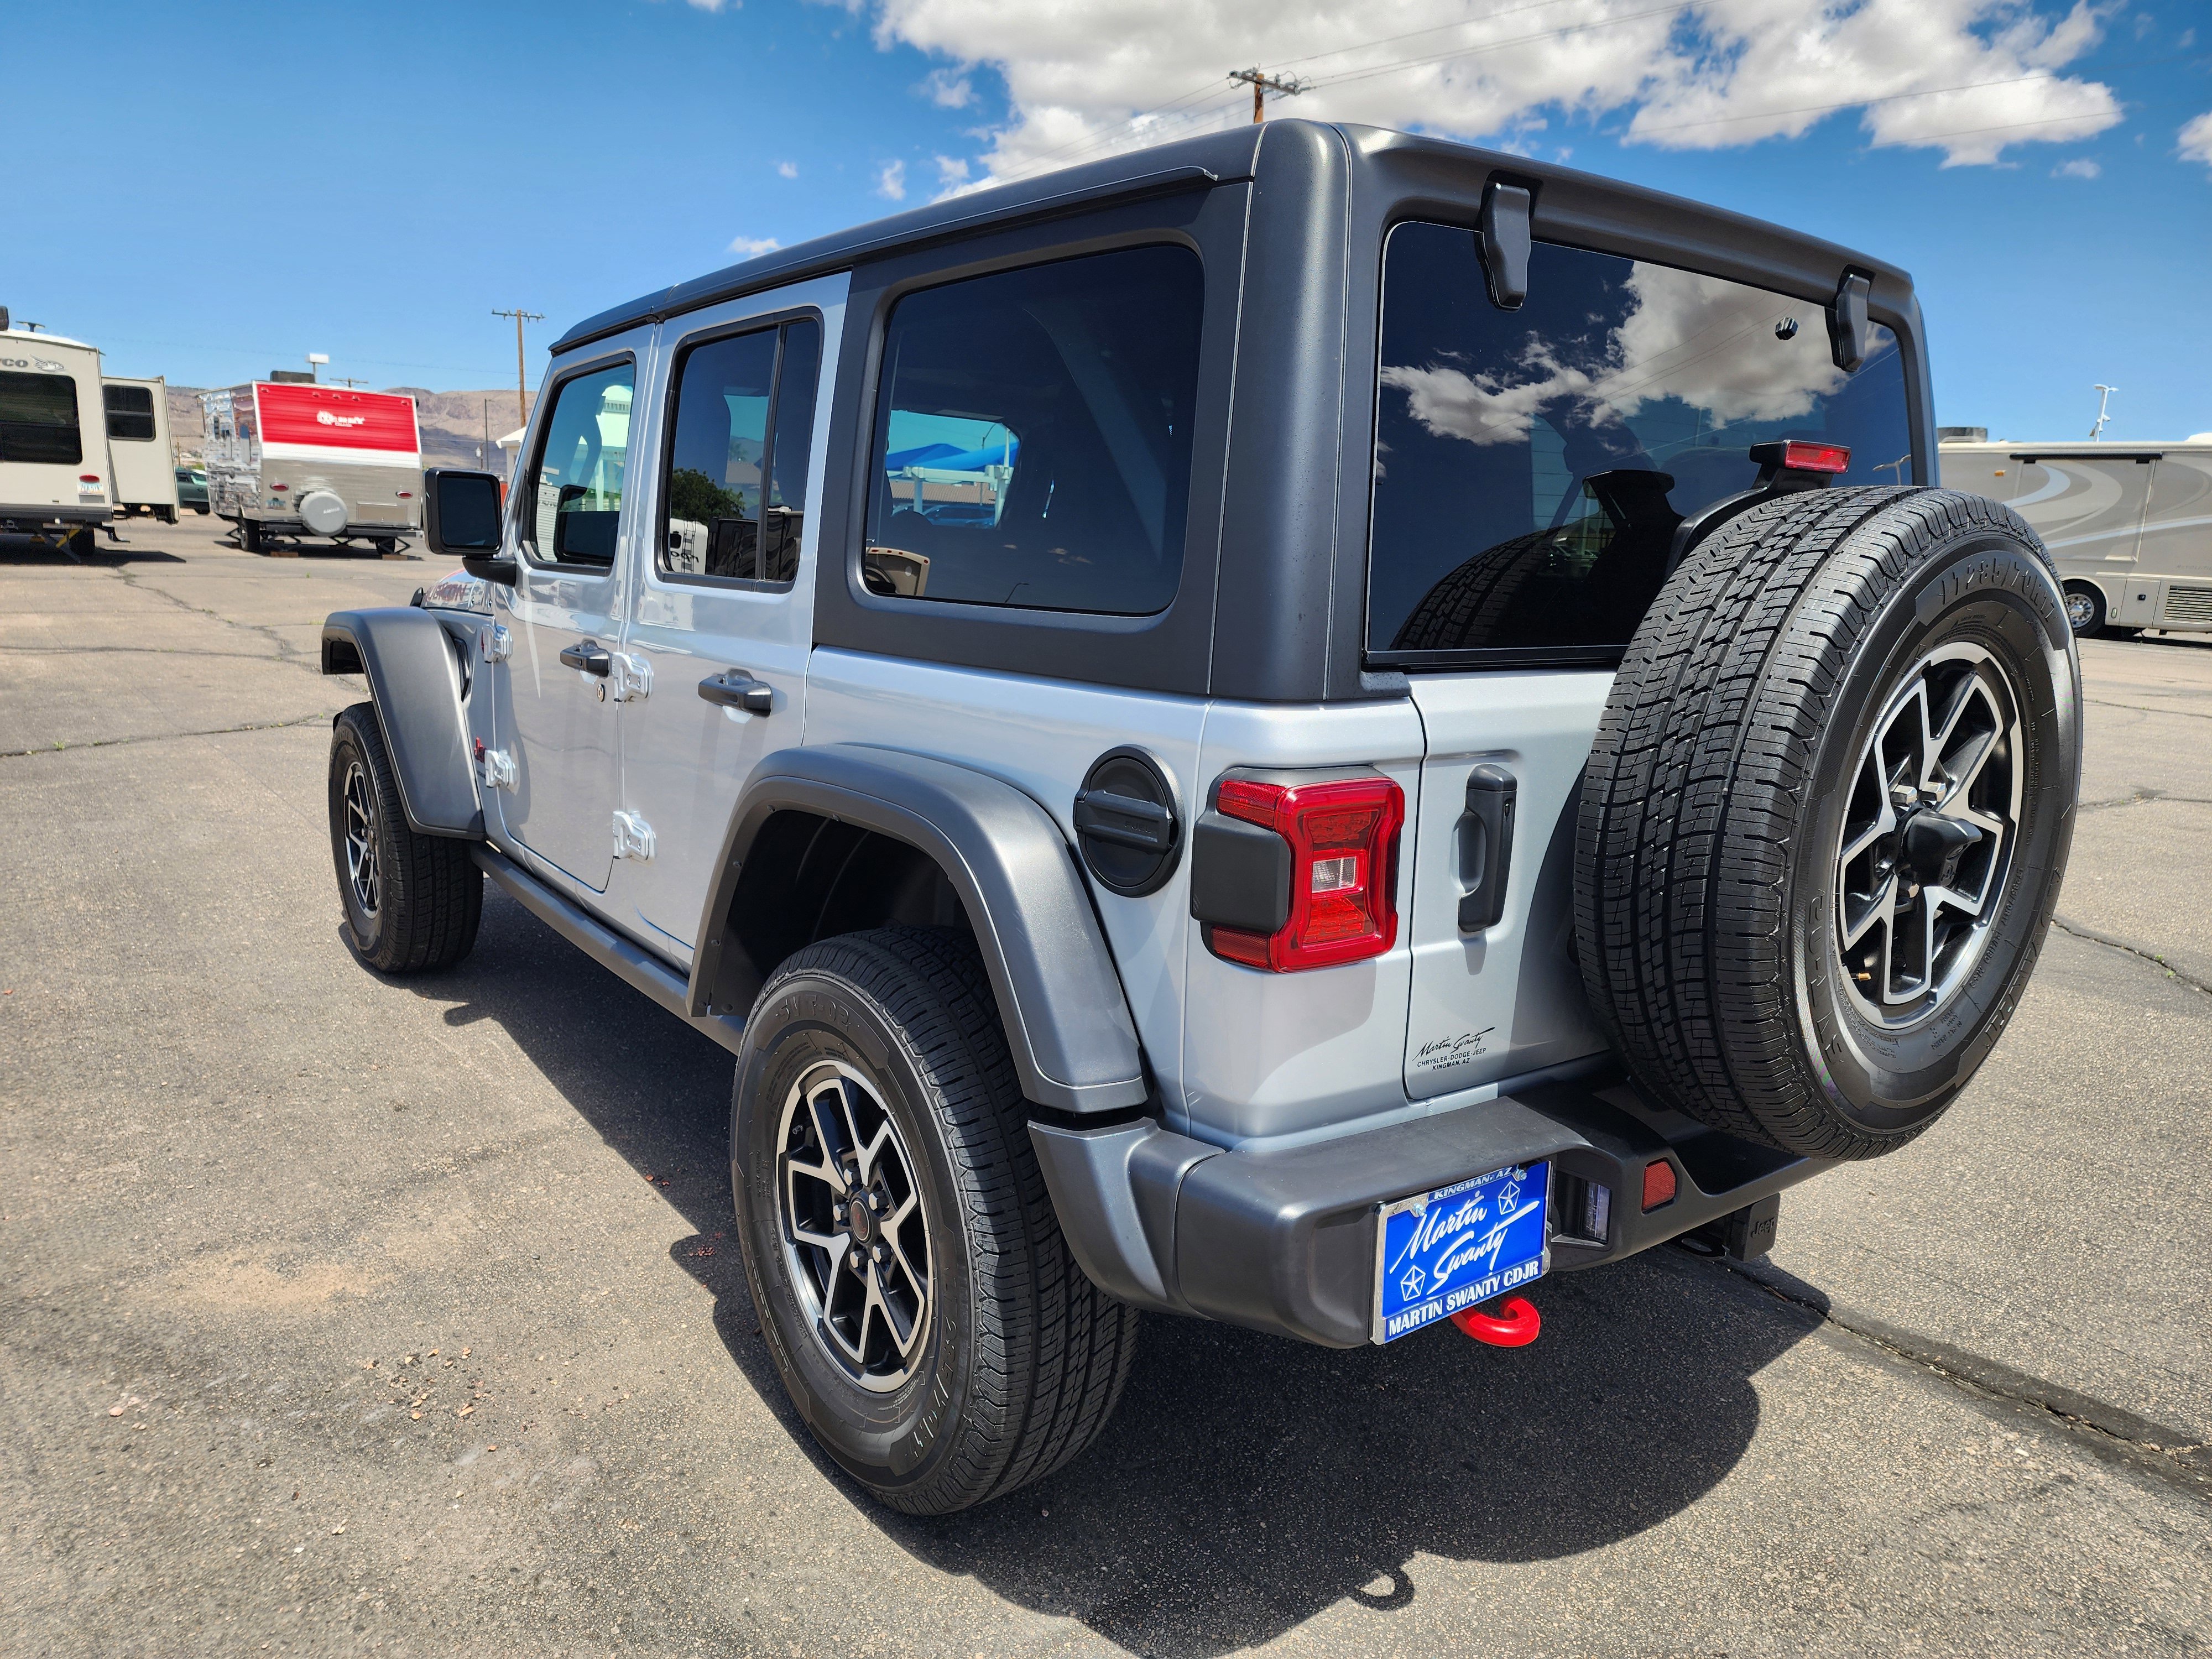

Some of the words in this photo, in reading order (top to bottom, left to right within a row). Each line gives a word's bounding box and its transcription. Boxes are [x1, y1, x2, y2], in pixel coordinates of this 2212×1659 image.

[1412, 1036, 1452, 1062] Martin
[1449, 1026, 1496, 1055] Swanty
[1432, 1060, 1461, 1071] KINGMAN,
[1433, 1174, 1494, 1200] KINGMAN,
[1495, 1166, 1513, 1179] AZ
[1389, 1190, 1488, 1275] Martin
[1750, 1217, 1776, 1239] Jeep
[1425, 1200, 1540, 1296] Swanty
[1389, 1299, 1443, 1337] MARTIN
[1446, 1275, 1500, 1311] SWANTY
[1503, 1260, 1540, 1287] CDJR
